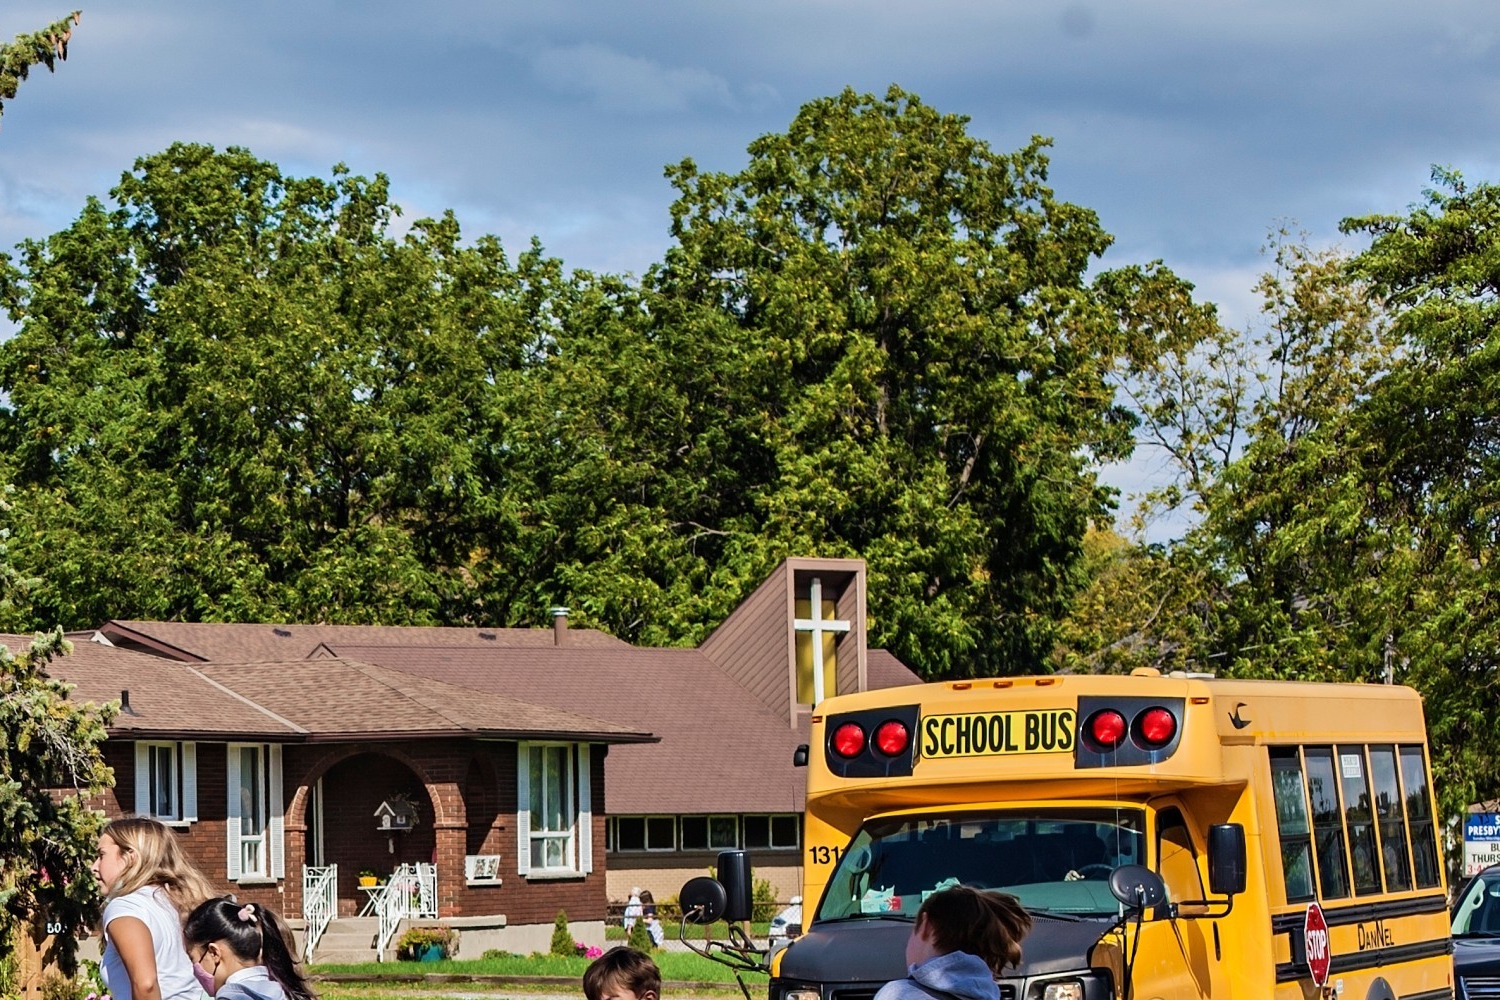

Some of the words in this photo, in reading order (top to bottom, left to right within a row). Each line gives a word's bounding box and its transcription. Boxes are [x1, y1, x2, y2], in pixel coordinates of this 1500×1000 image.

[925, 714, 1019, 756] SCHOOL
[1025, 711, 1073, 751] BUS
[809, 846, 845, 865] 131
[1307, 929, 1327, 961] STOP
